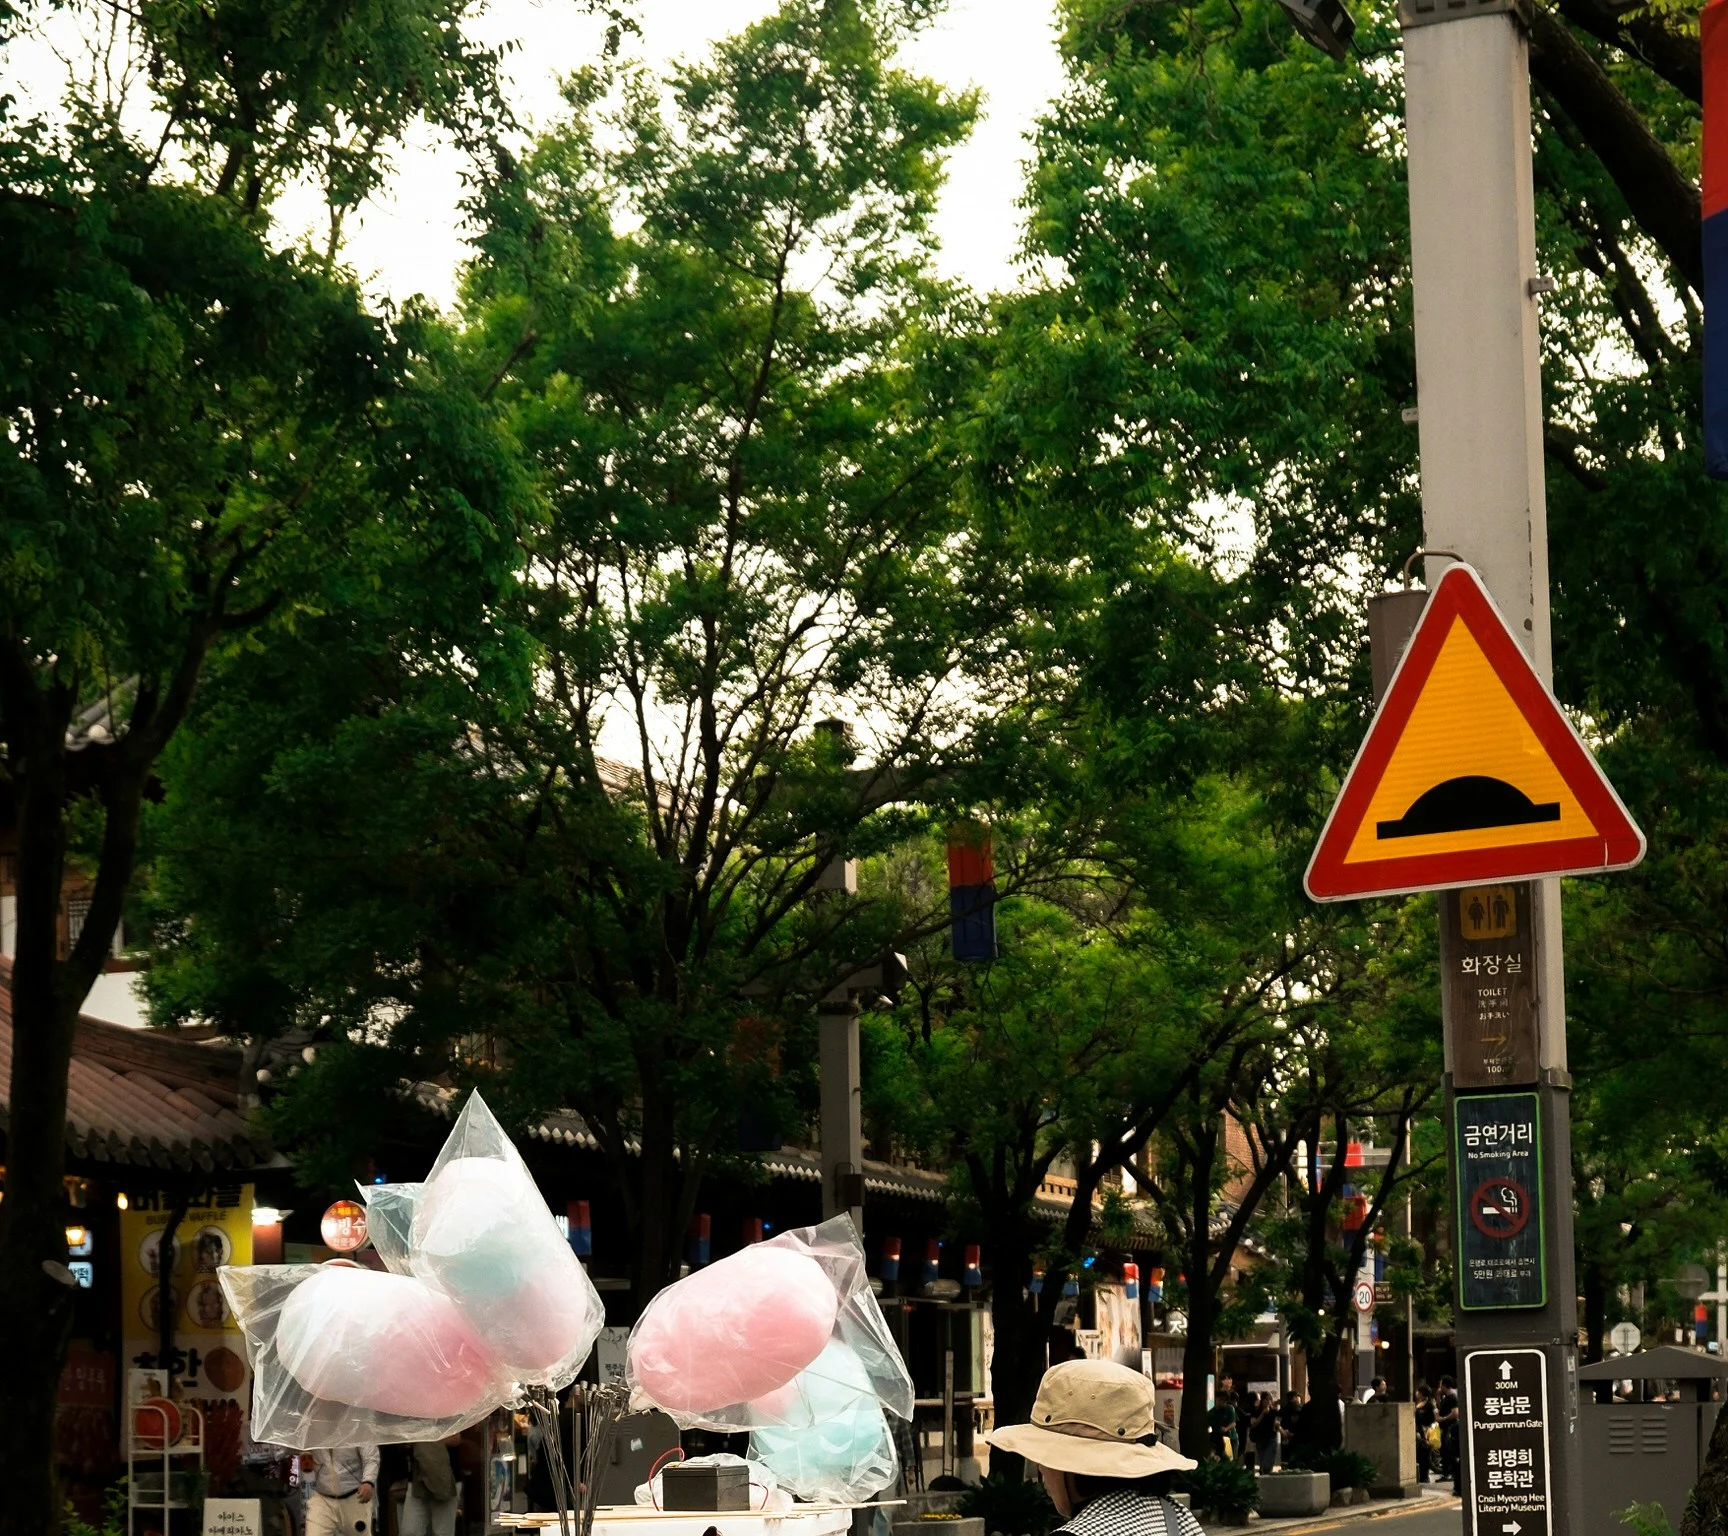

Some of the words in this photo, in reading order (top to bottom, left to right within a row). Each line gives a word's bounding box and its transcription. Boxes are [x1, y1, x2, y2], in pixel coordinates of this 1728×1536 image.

[1461, 953, 1522, 976] 화장실
[1478, 987, 1508, 997] TOILET
[1464, 1122, 1533, 1146] 금연거리
[1479, 1151, 1511, 1159] Smoking
[189, 1210, 228, 1222] WAFFLE
[1474, 1269, 1493, 1279] 5만원
[1359, 1291, 1370, 1304] 20
[1495, 1381, 1518, 1390] 300M
[1484, 1396, 1531, 1416] 풍남문
[1473, 1420, 1526, 1431] Pungnammun
[1526, 1419, 1543, 1428] Gate
[1486, 1448, 1533, 1468] 최명희
[1487, 1470, 1534, 1489] 문학관
[1496, 1494, 1528, 1504] Myeong
[1528, 1493, 1545, 1502] Hee
[1478, 1504, 1510, 1514] Literary
[1510, 1504, 1545, 1512] Museum
[217, 1512, 245, 1522] 아이스
